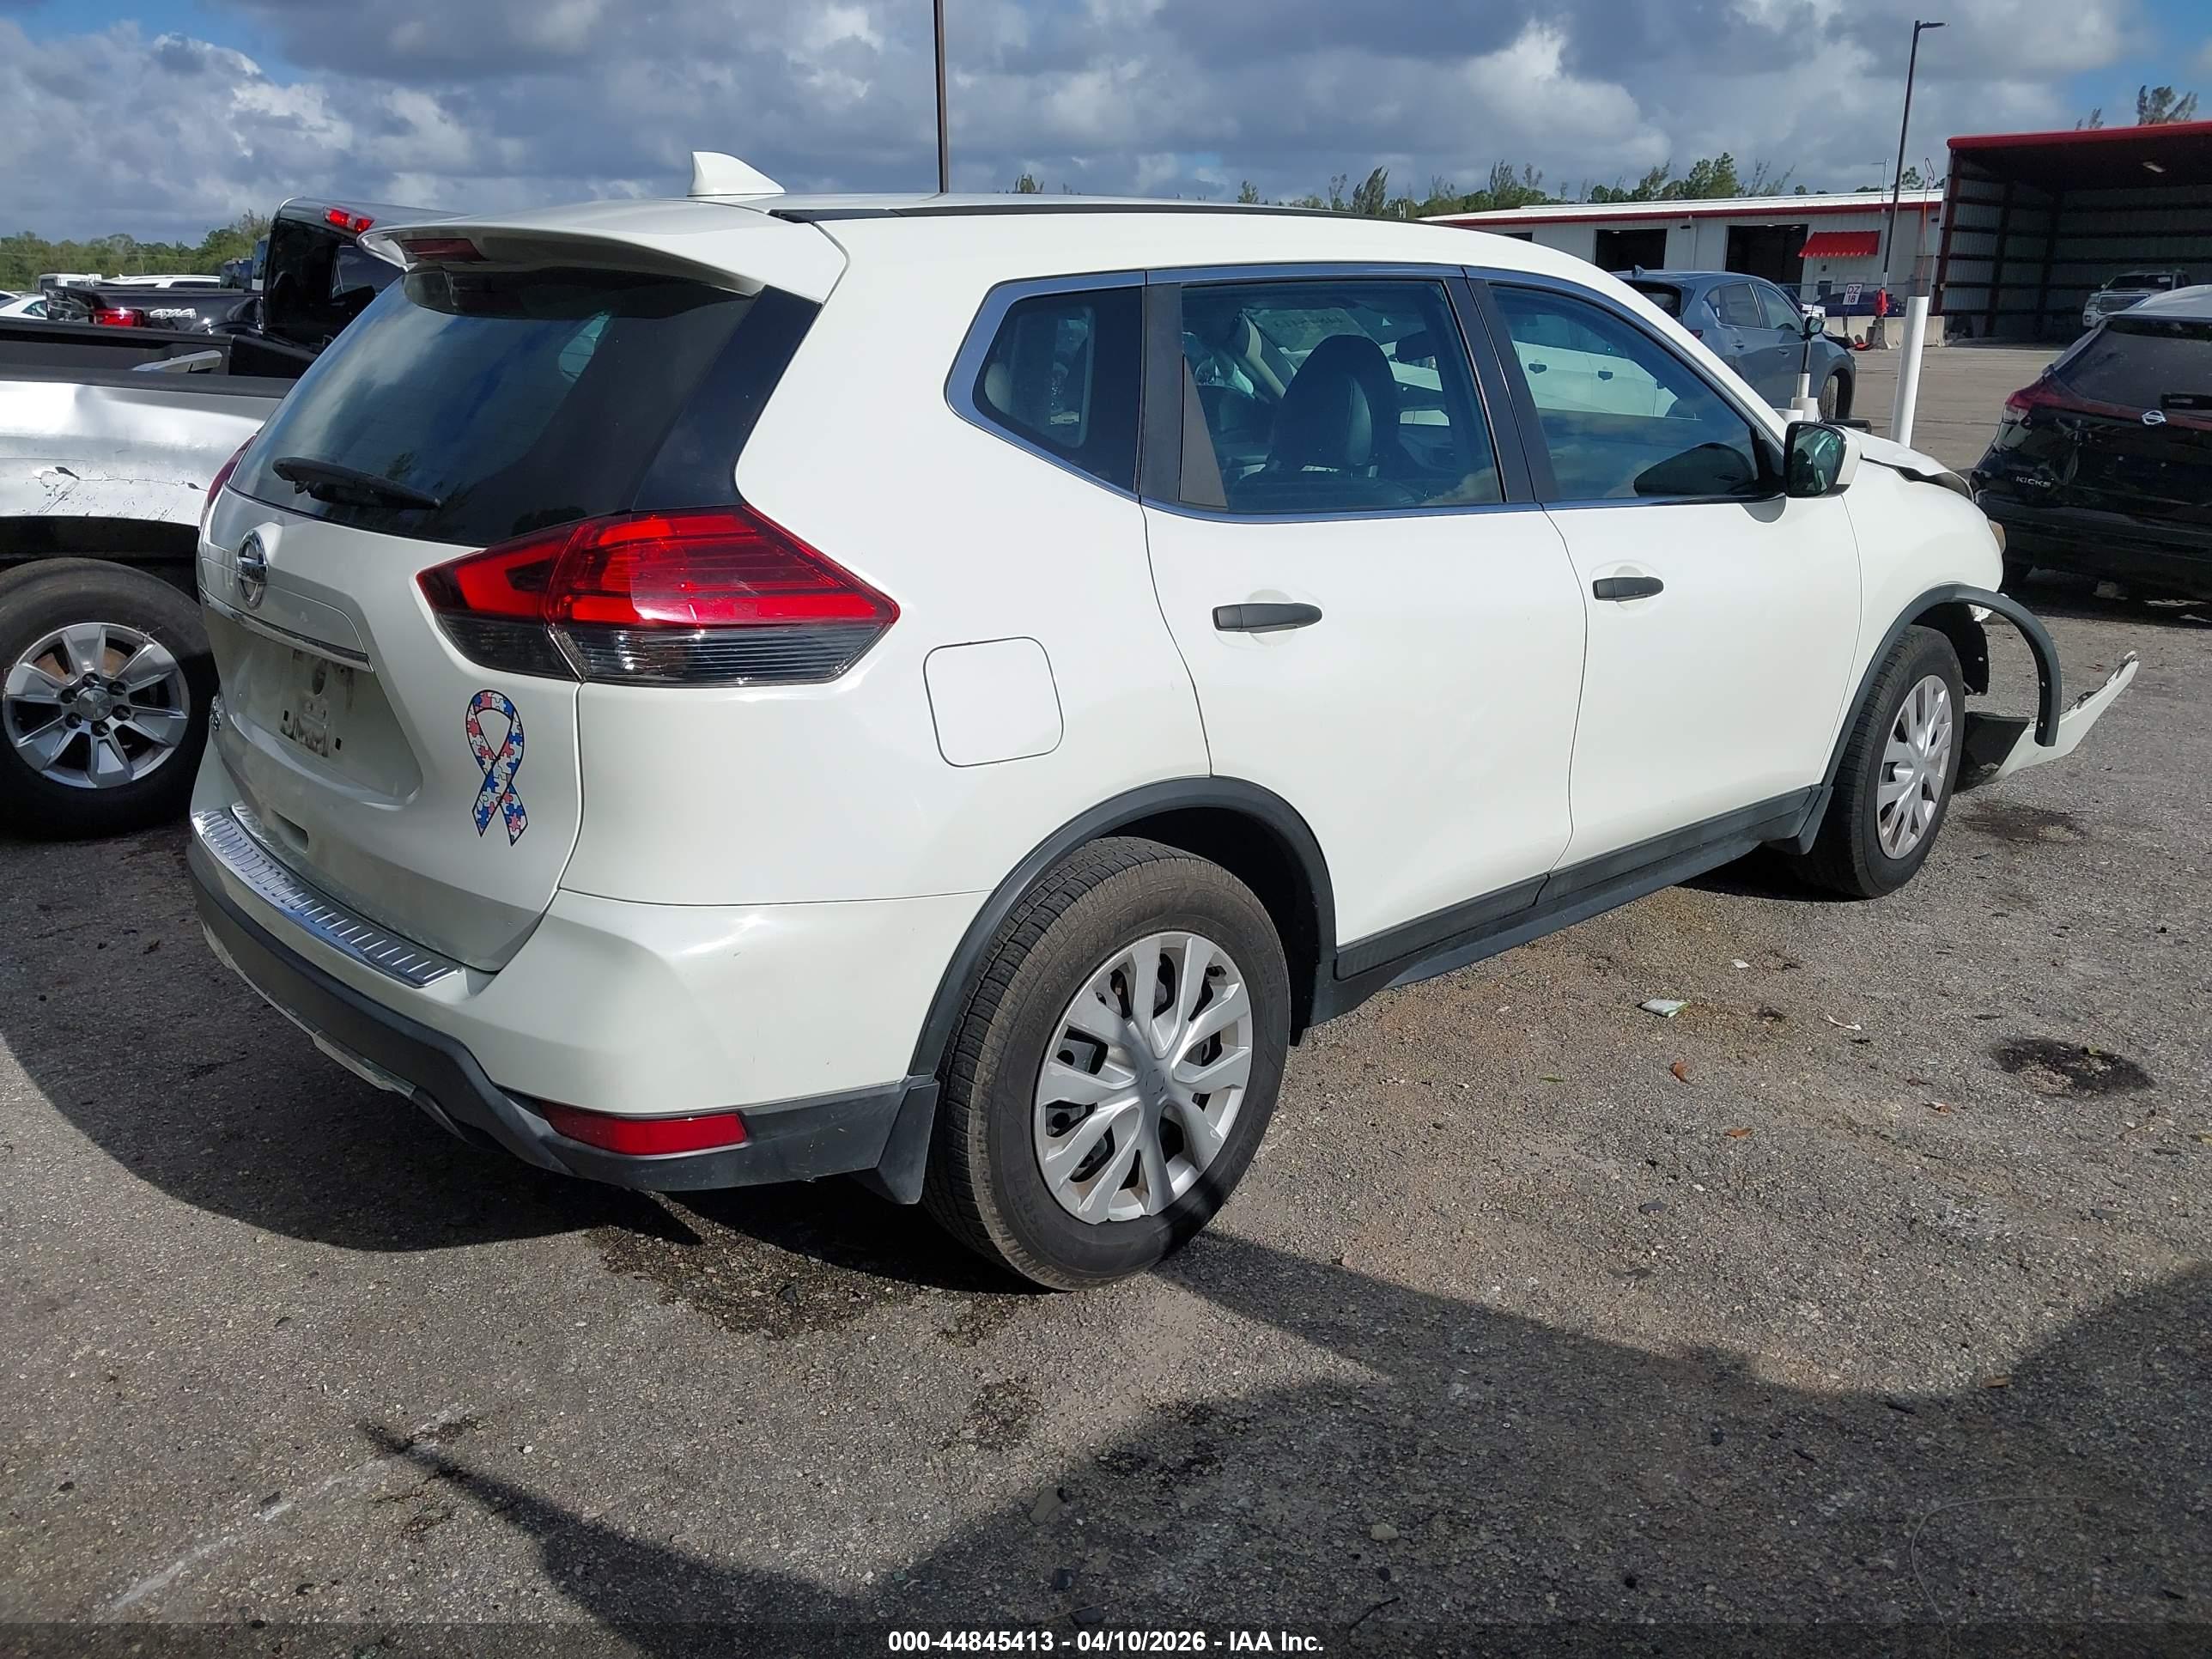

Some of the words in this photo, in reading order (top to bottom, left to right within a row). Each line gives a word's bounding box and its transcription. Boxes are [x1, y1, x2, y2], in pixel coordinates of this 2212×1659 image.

[1847, 285, 1862, 295] DZ
[1847, 295, 1856, 303] 18
[2015, 476, 2051, 488] KICKS
